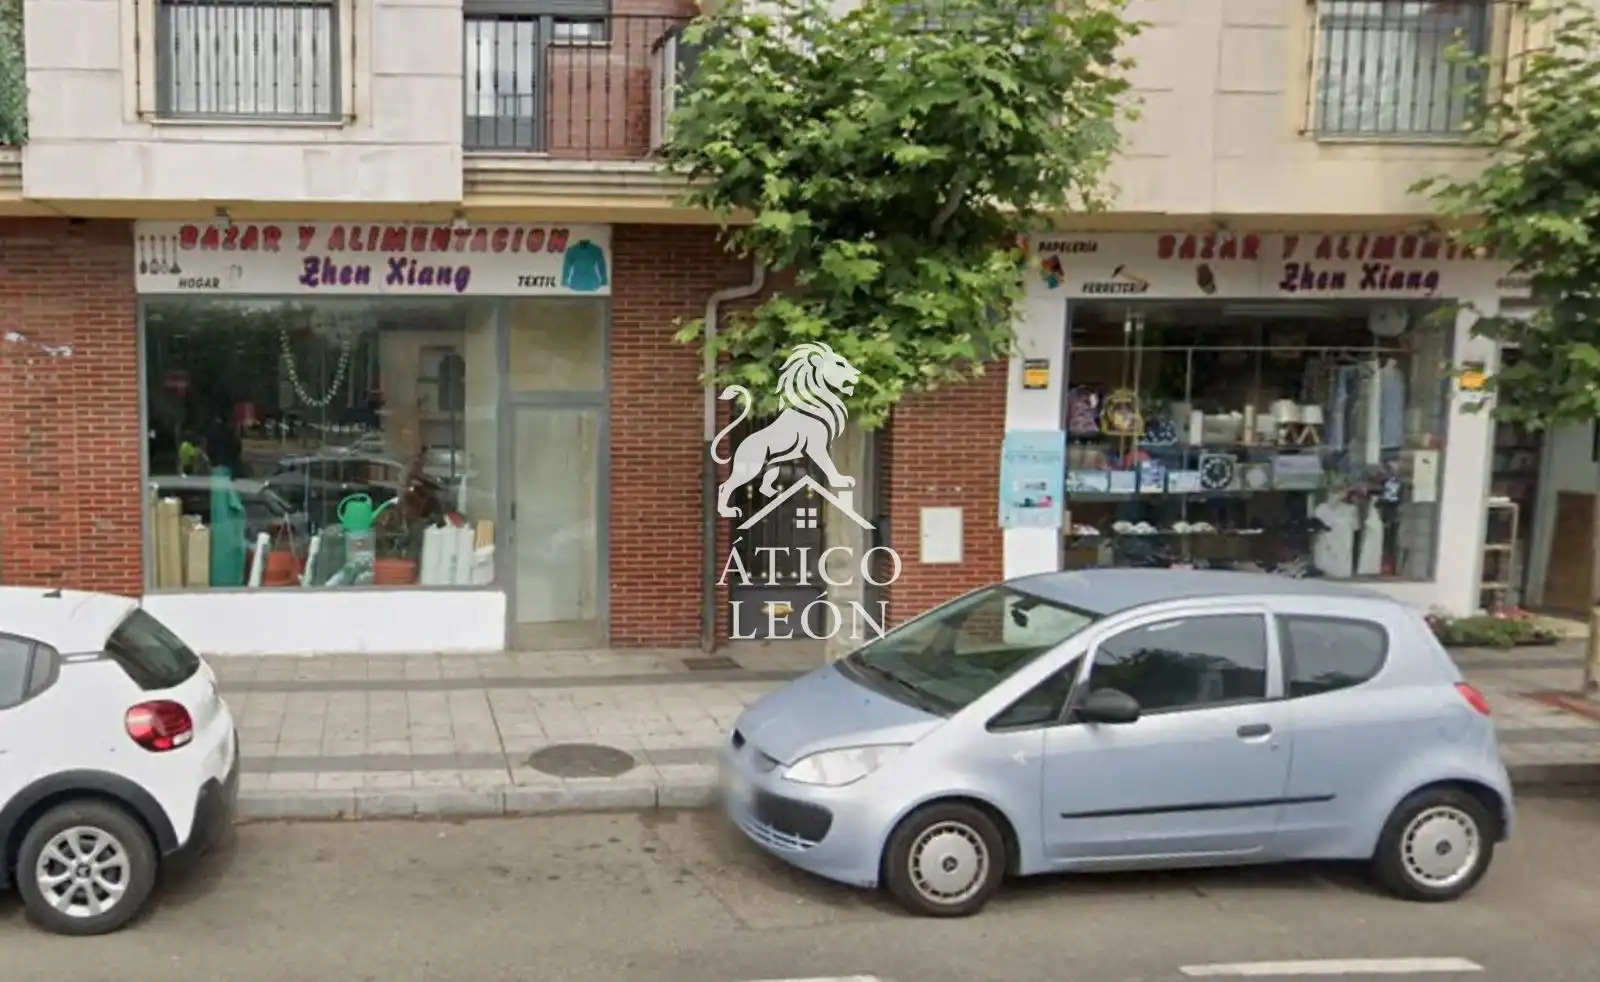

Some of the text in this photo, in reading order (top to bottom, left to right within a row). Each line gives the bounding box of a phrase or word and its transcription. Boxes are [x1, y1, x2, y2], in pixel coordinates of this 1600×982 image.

[179, 225, 570, 253] BAZAR Y ALIMENTACION
[1157, 234, 1260, 261] BAZAR
[1282, 235, 1298, 260] Y
[178, 277, 220, 289] HOGAR
[299, 254, 471, 293] Zhen Xiang
[517, 275, 556, 288] TEXTIL
[1280, 262, 1439, 296] Zhen Xiang
